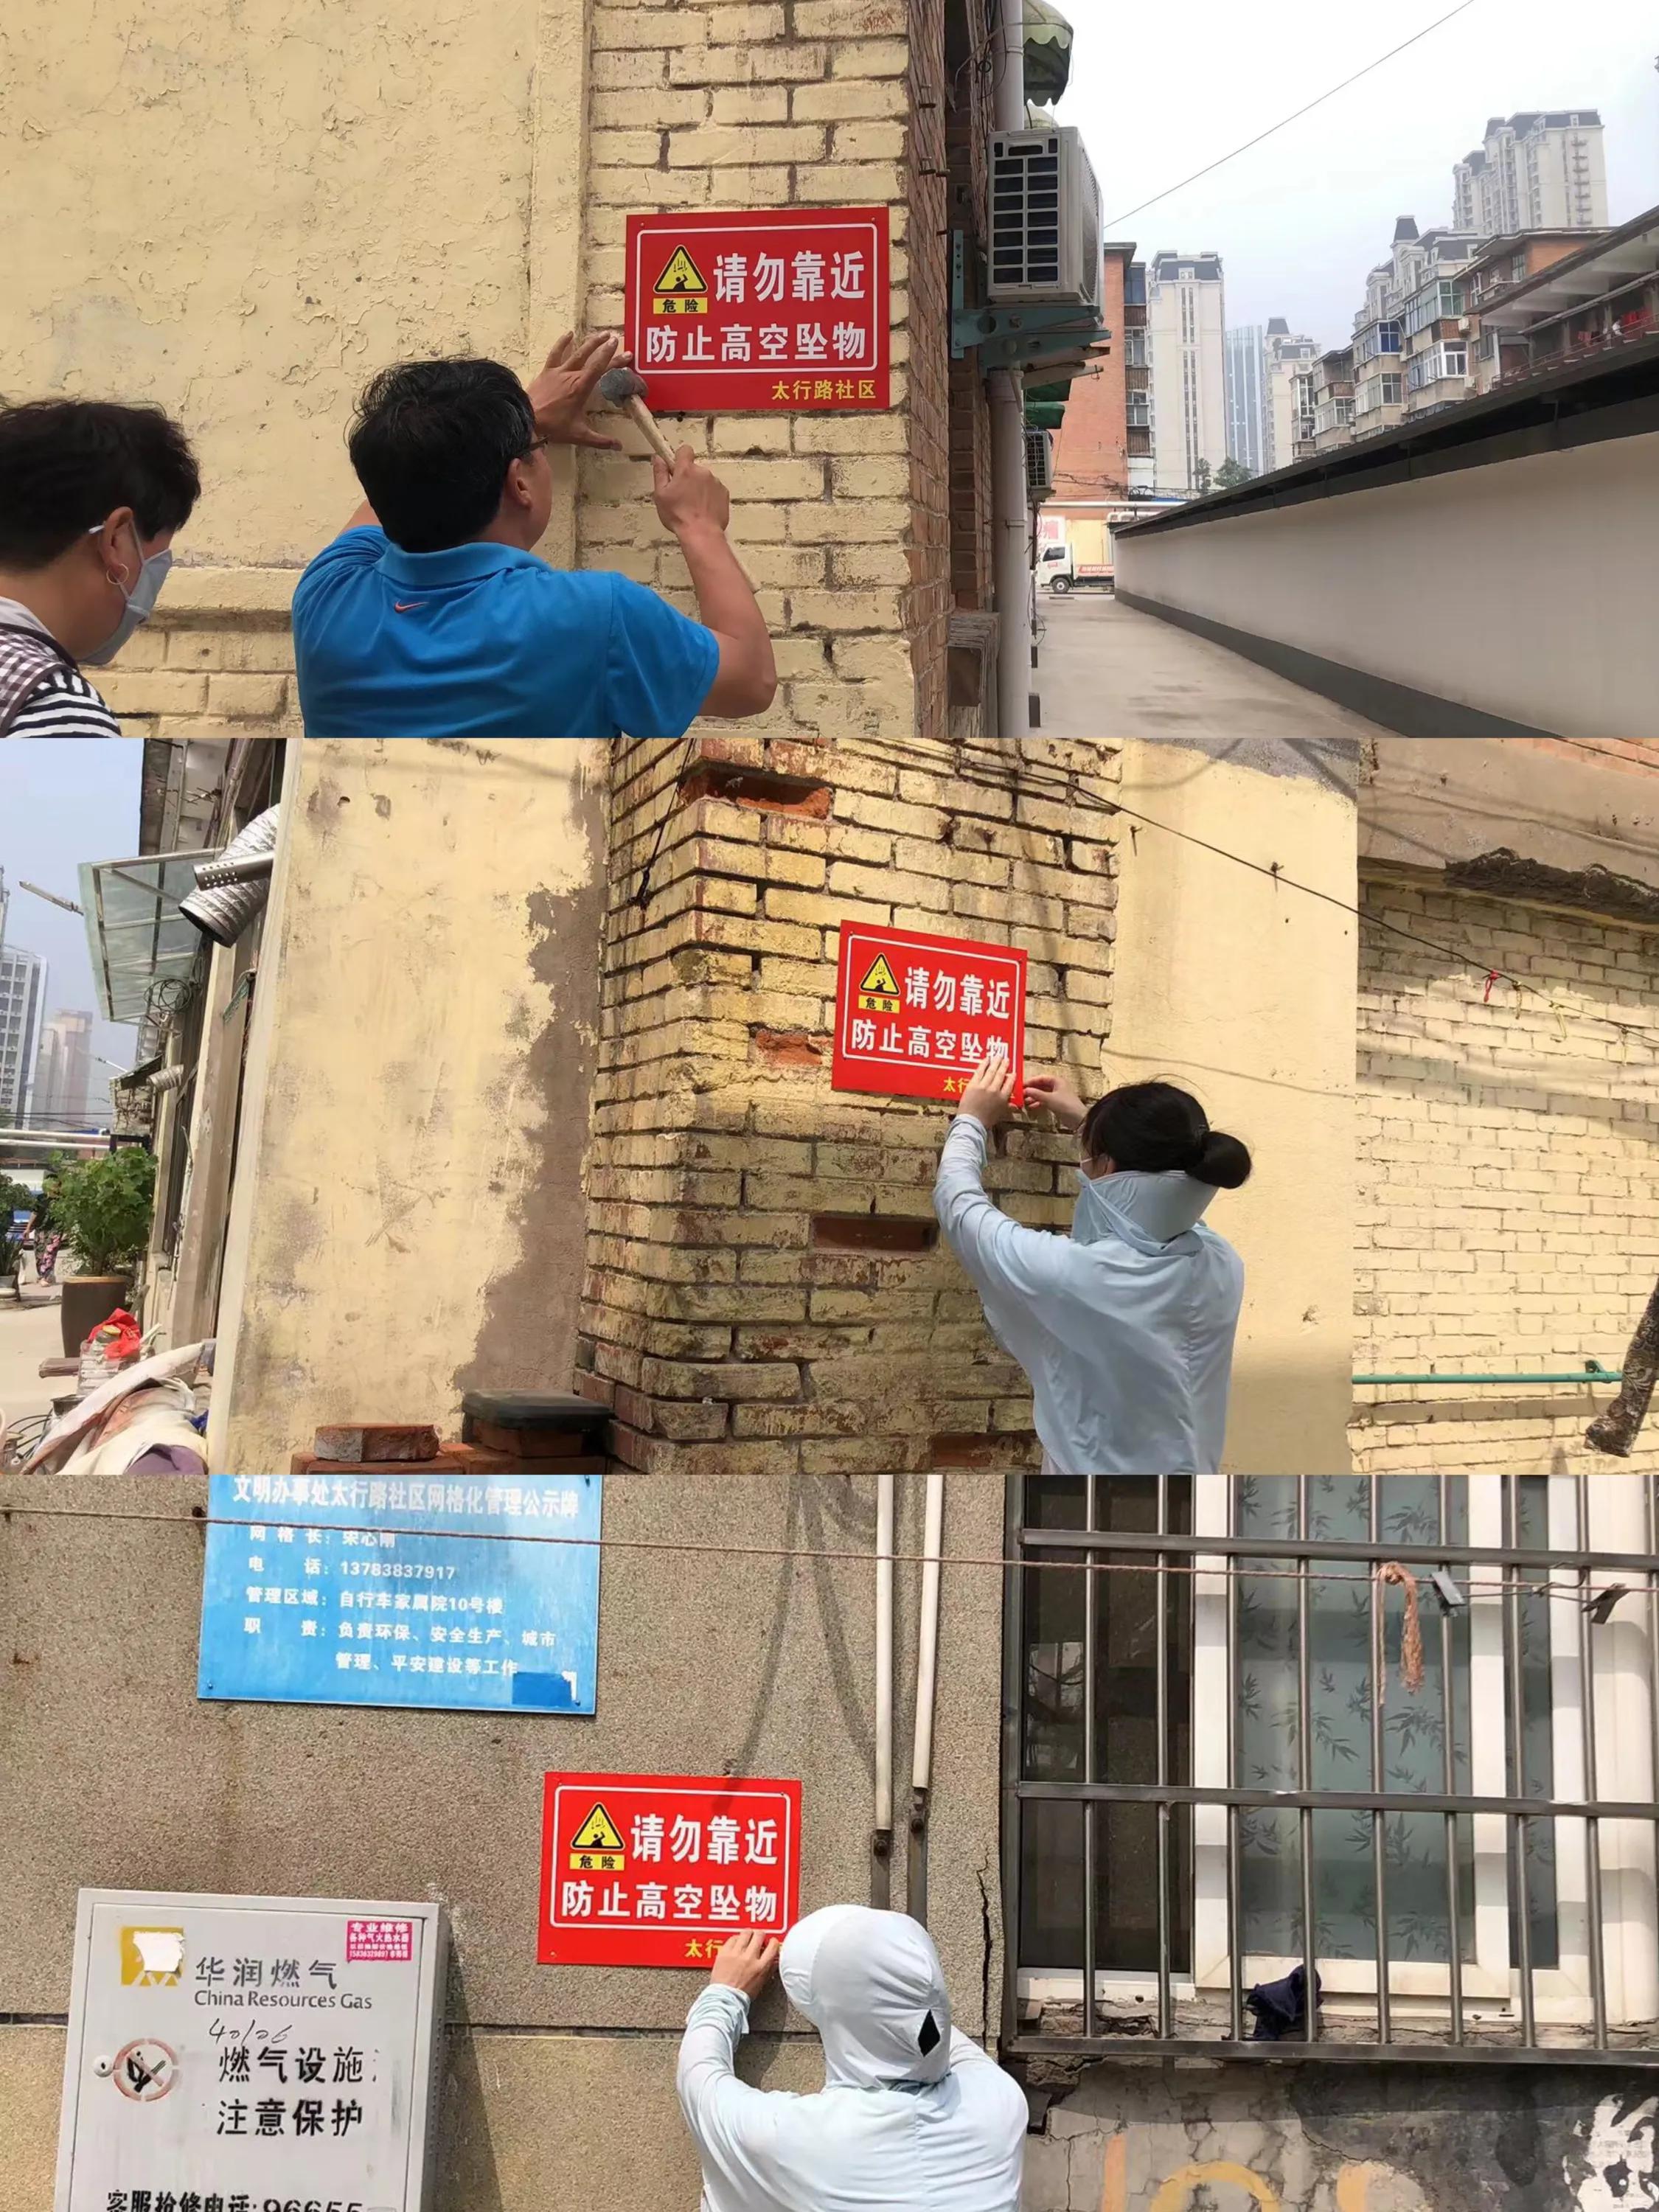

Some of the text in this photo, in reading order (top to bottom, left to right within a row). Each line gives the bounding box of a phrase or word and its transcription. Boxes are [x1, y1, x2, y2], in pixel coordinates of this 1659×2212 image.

[713, 250, 866, 303] 请勿靠近
[662, 299, 699, 313] 危险
[646, 321, 866, 363] 防止高空坠物
[771, 380, 876, 400] 太行路社区
[866, 998, 893, 1012] 危险
[905, 967, 1010, 1019] 请勿靠近
[851, 1018, 1009, 1064] 防止高空坠物
[630, 1813, 778, 1865] 请勿靠近
[579, 1855, 616, 1869] 危险
[561, 1879, 777, 1923] 防止高空坠物
[195, 1956, 337, 1990] 华润燃气
[194, 1990, 372, 2009] China Resources Gas
[219, 2045, 364, 2084] 燃气设施
[216, 2098, 364, 2137] 注意保护
